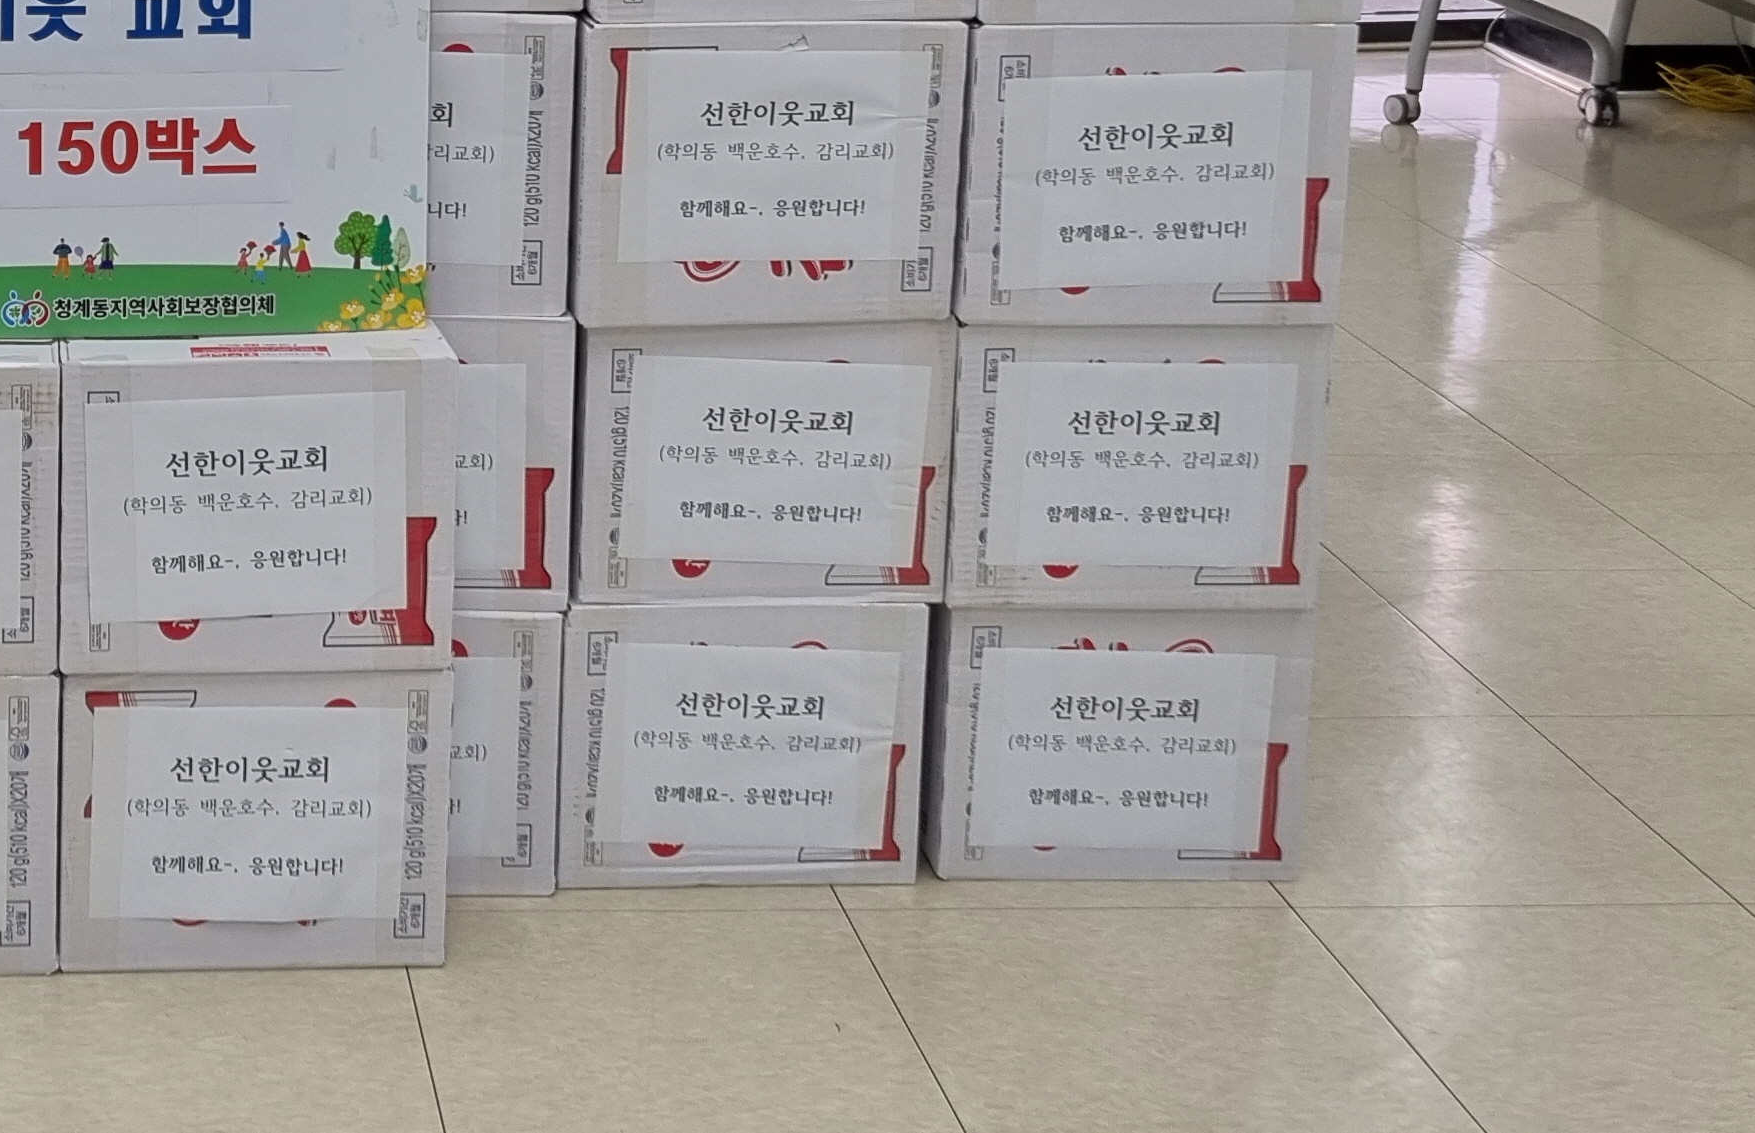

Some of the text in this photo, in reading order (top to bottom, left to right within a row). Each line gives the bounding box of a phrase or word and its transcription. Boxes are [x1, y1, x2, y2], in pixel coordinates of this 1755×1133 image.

[699, 99, 855, 128] 선한이웃교회
[17, 117, 258, 178] 150박스
[1077, 120, 1234, 153] 선한이웃교회
[772, 198, 866, 218] 응원합니다!
[1152, 220, 1248, 242] 응원합니다!
[53, 292, 276, 319] 청계동지역사회보장협의체
[701, 405, 854, 437] 선한이웃교회
[1067, 409, 1221, 437] 선한이웃교회
[165, 444, 328, 479] 선한이웃교회
[770, 503, 862, 524] 응원합니다!
[1137, 505, 1231, 525] 응원합니다!
[249, 547, 347, 570] 응원합니다!
[674, 691, 826, 722] 선한이웃교회
[1049, 694, 1201, 724] 선한이웃교회
[169, 755, 330, 784] 선한이웃교회
[743, 786, 834, 807] 응원합니다!
[1118, 789, 1209, 810] 응원합니다!
[248, 856, 344, 878] 응원합니다!
